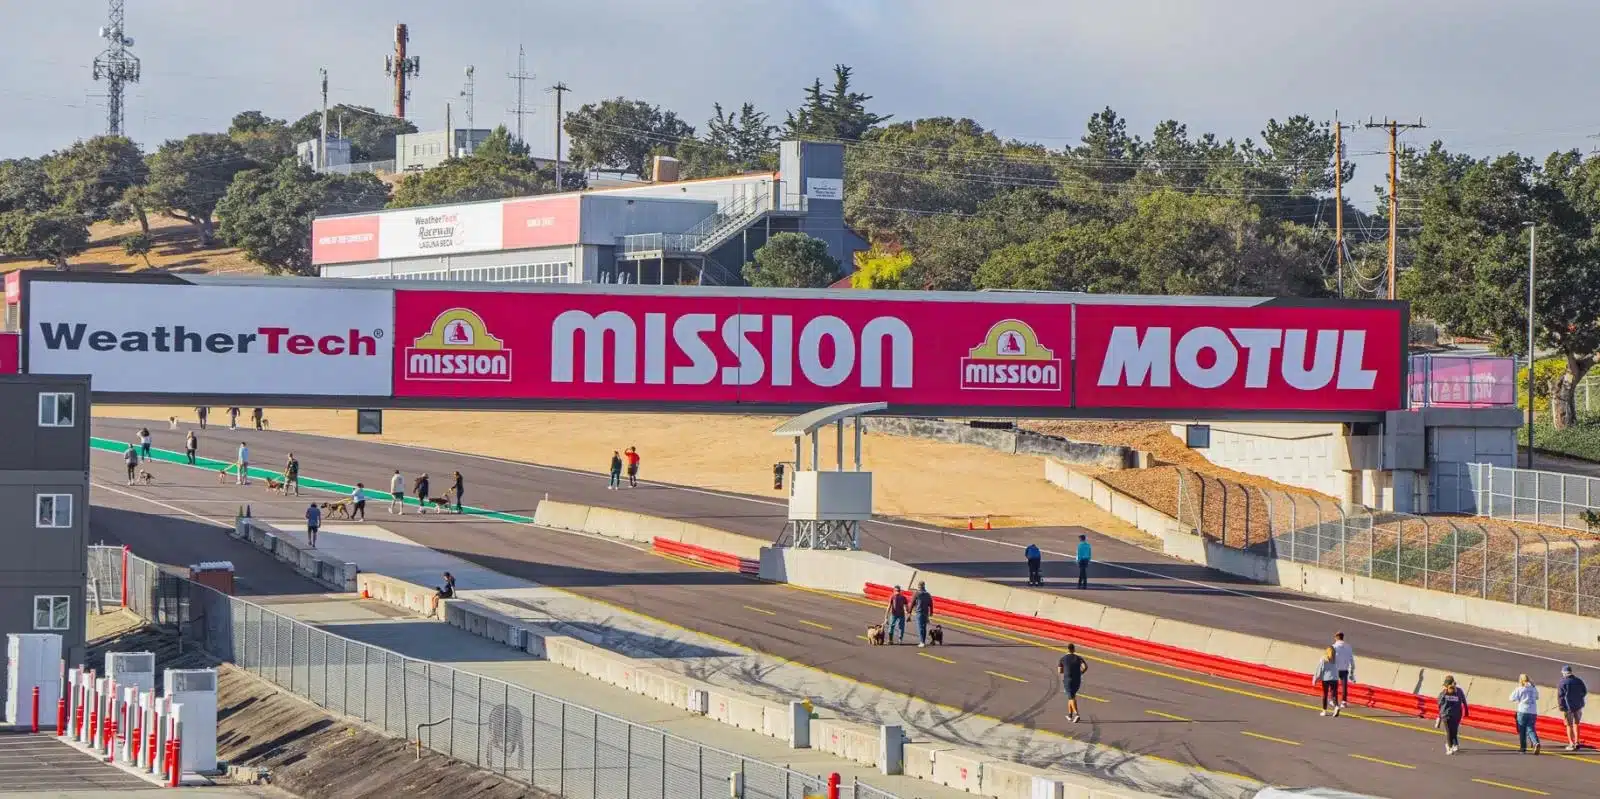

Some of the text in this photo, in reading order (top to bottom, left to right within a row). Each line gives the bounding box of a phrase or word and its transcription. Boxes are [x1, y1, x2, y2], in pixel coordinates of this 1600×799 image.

[419, 226, 454, 240] Raceway
[551, 309, 913, 388] MISSION
[1097, 326, 1378, 391] MOTUL
[410, 354, 507, 375] MISSION
[966, 364, 1057, 384] MISSION
